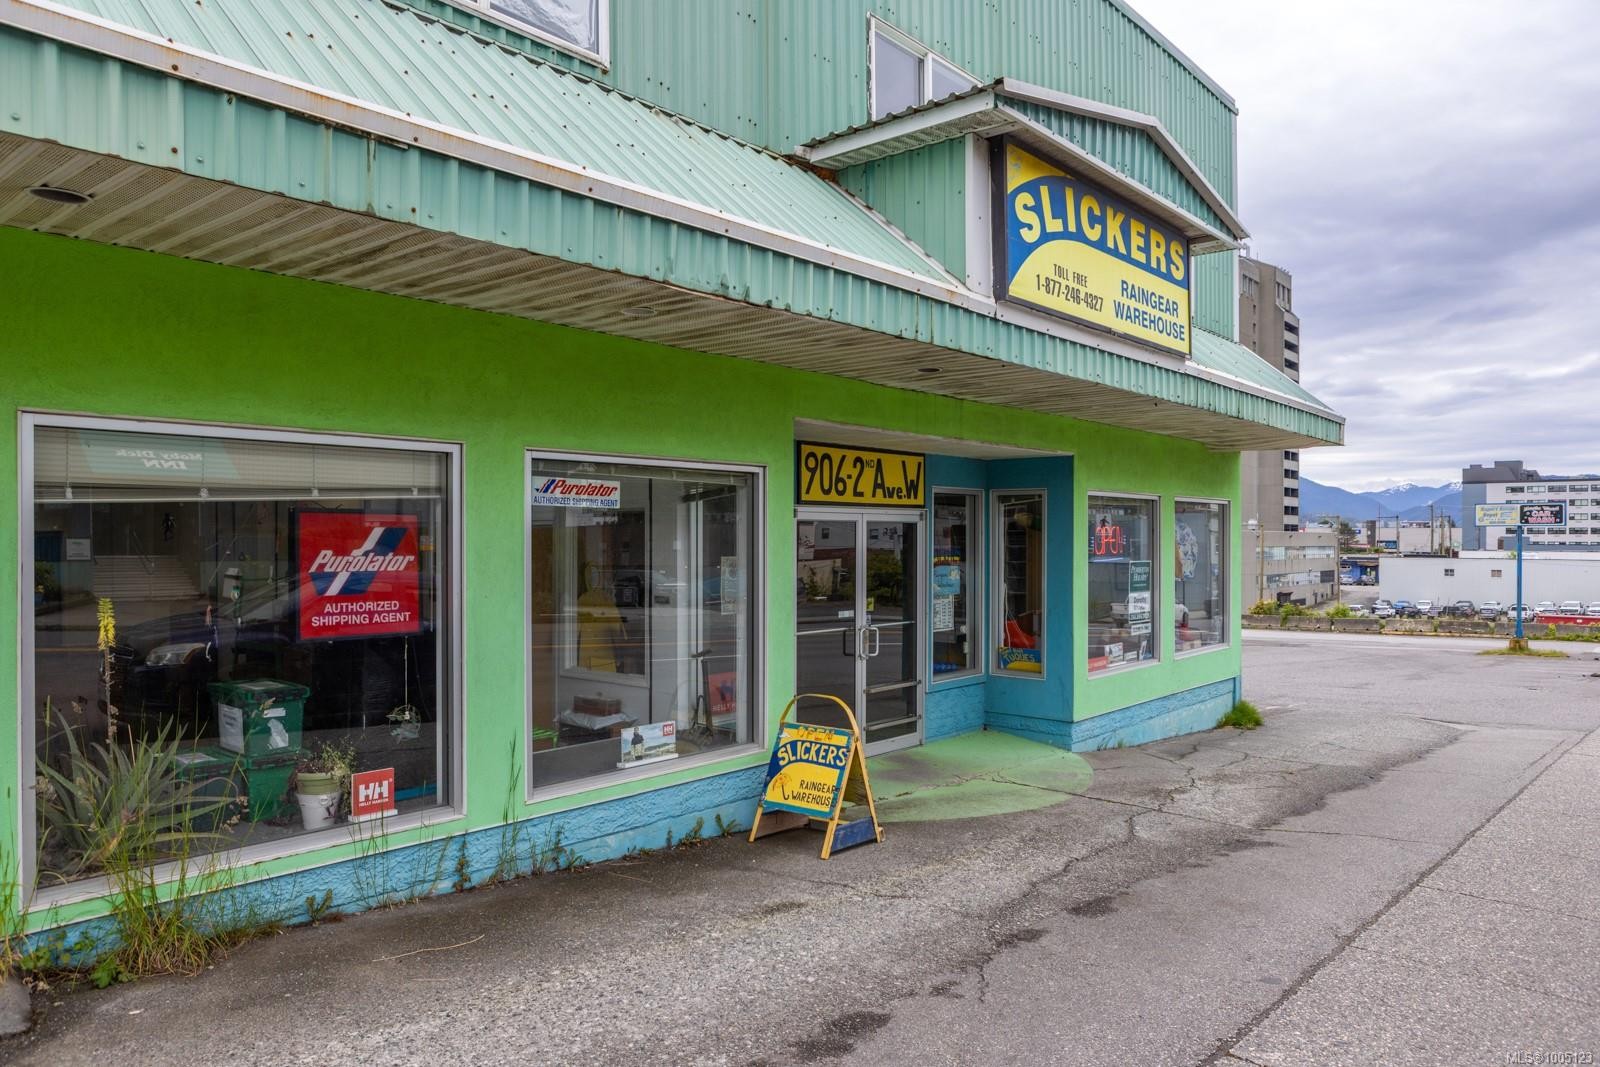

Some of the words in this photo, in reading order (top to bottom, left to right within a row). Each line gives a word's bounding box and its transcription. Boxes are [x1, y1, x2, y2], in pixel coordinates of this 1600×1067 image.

[1015, 185, 1185, 281] SLICKERS
[1053, 264, 1070, 282] TOLL
[1073, 272, 1088, 288] FREE
[1036, 274, 1104, 312] 1-877-246-4327
[1121, 280, 1179, 318] RAINGEAR
[1114, 300, 1185, 341] WAREHOUSE
[550, 479, 618, 496] Purolator
[533, 496, 570, 505] AUTHORIZED
[572, 498, 599, 506] SHIPPING
[600, 499, 618, 507] AGENT
[308, 549, 415, 573] Purolator
[324, 601, 399, 613] AUTHORIZED
[311, 614, 369, 627] SHIPPING
[372, 612, 411, 623] AGENT
[777, 741, 849, 766] SLICKERS
[358, 780, 389, 802] HH
